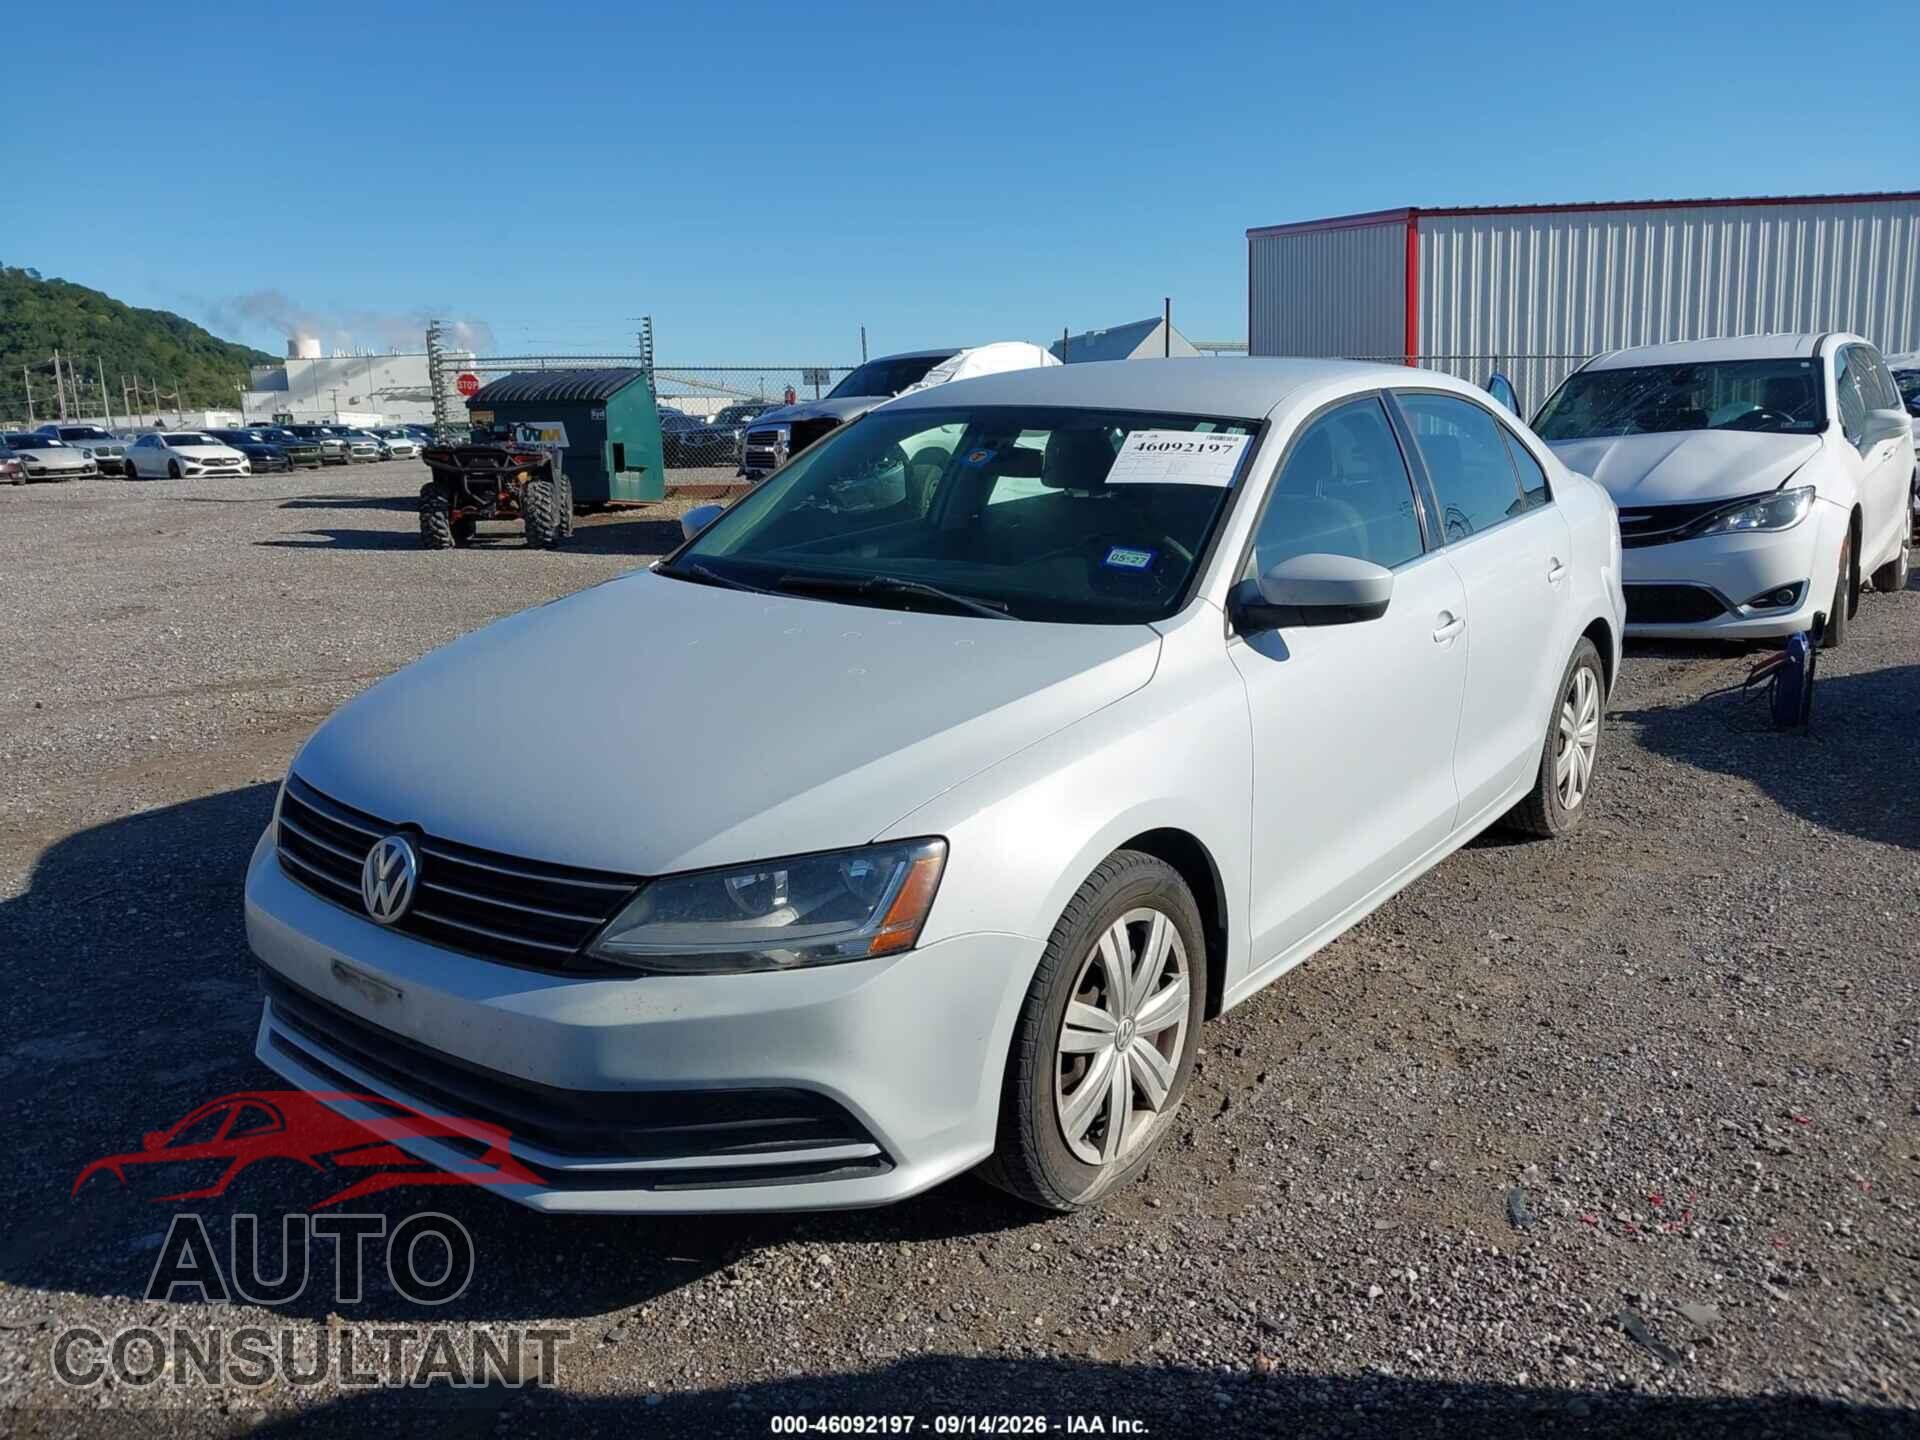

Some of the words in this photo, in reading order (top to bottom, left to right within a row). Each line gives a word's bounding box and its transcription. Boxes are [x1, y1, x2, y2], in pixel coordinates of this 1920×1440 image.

[458, 380, 479, 390] STOP
[520, 428, 561, 442] WM
[1133, 441, 1234, 454] 46092197
[361, 835, 417, 924] VW
